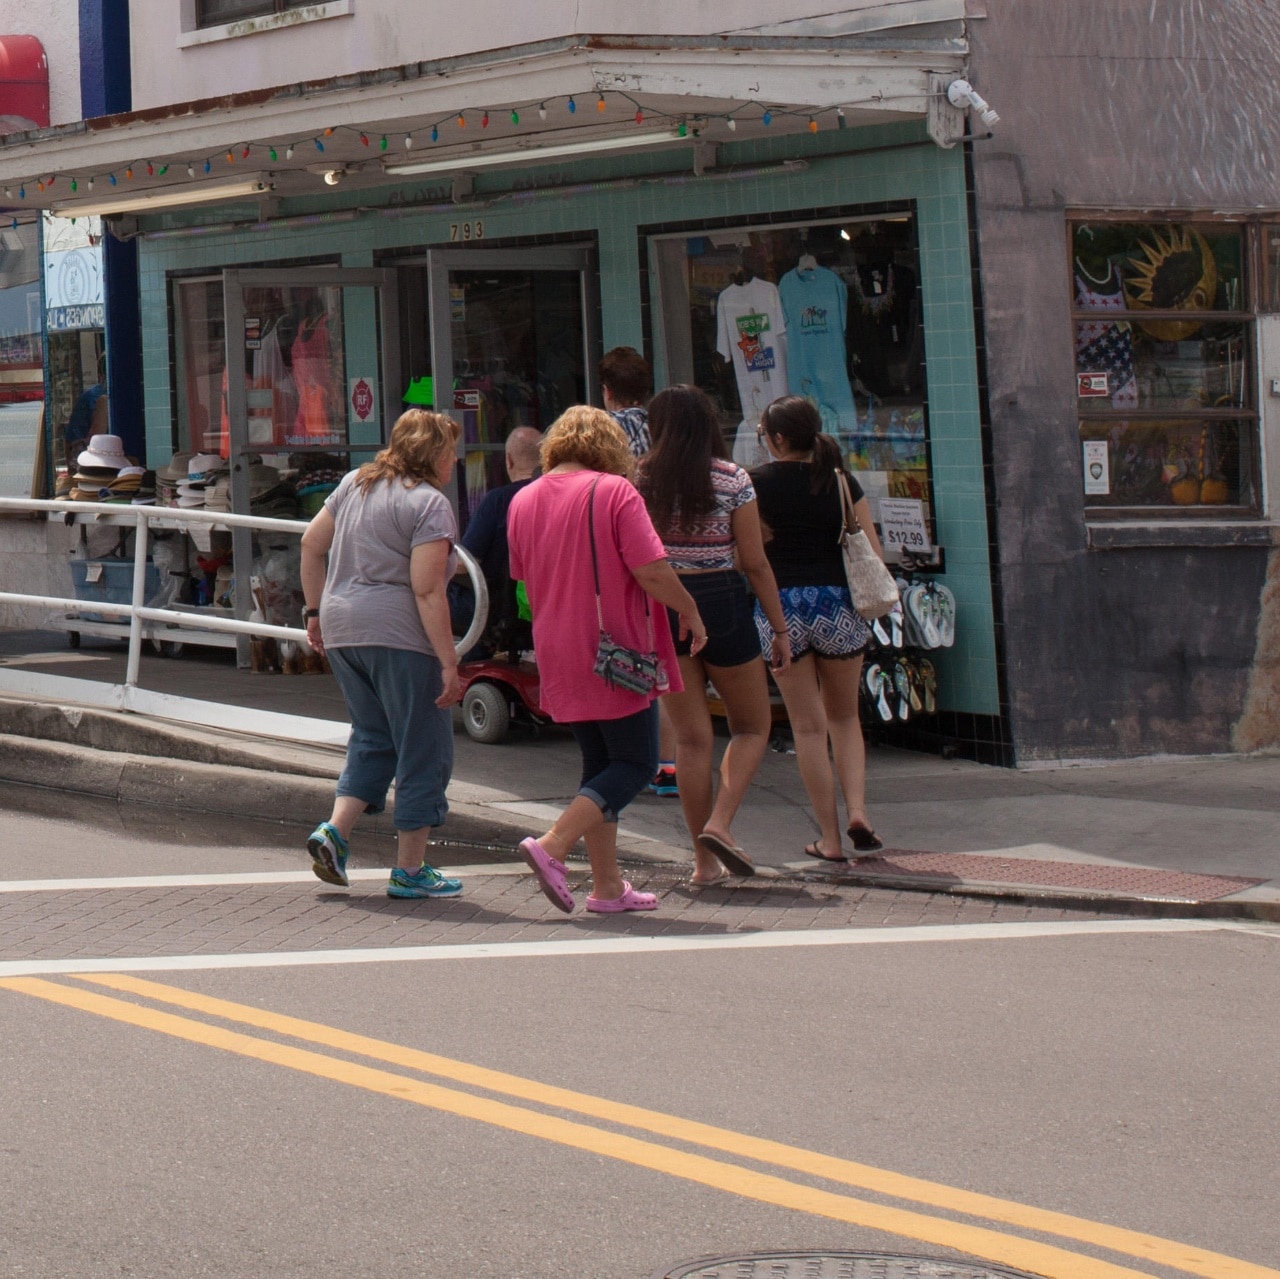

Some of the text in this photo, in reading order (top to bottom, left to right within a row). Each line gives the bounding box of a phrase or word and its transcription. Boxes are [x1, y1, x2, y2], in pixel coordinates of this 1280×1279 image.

[451, 221, 483, 241] 793
[357, 395, 368, 406] RF
[888, 530, 924, 546] $12.99
